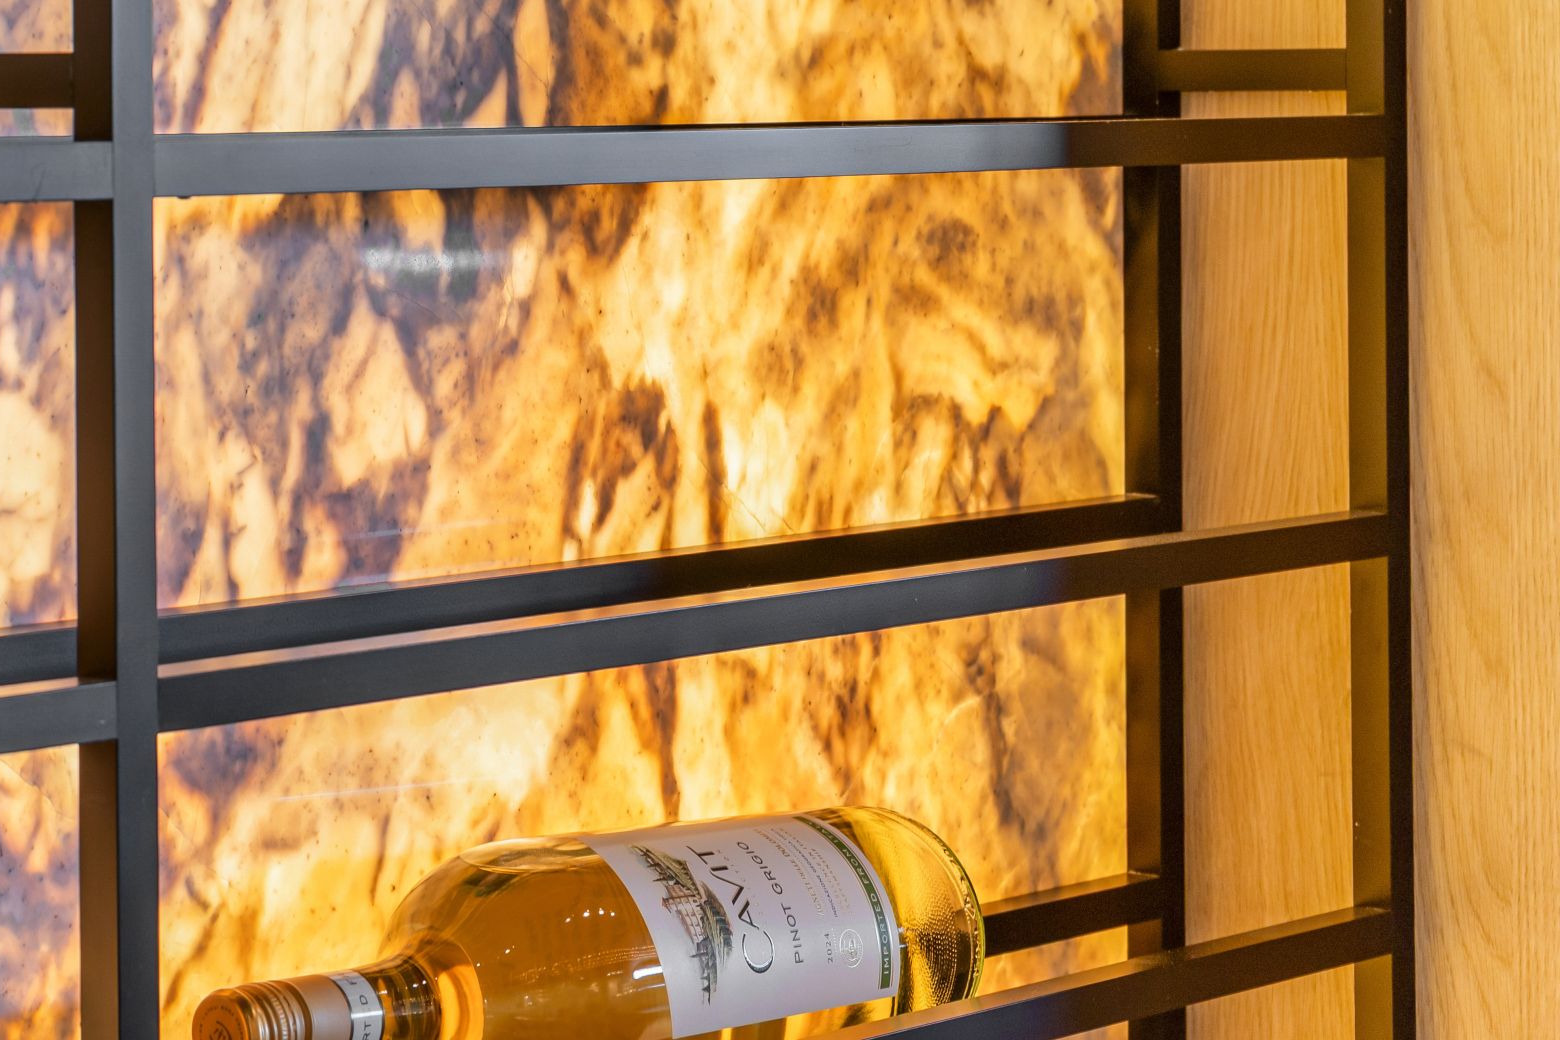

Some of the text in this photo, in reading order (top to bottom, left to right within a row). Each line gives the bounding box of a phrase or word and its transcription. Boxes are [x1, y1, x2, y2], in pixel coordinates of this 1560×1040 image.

[737, 841, 804, 964] PINOT GRIGIO
[842, 848, 869, 884] FROM
[686, 845, 775, 974] CAVIT
[825, 932, 833, 964] 2024
[869, 892, 890, 974] IMPORTED
